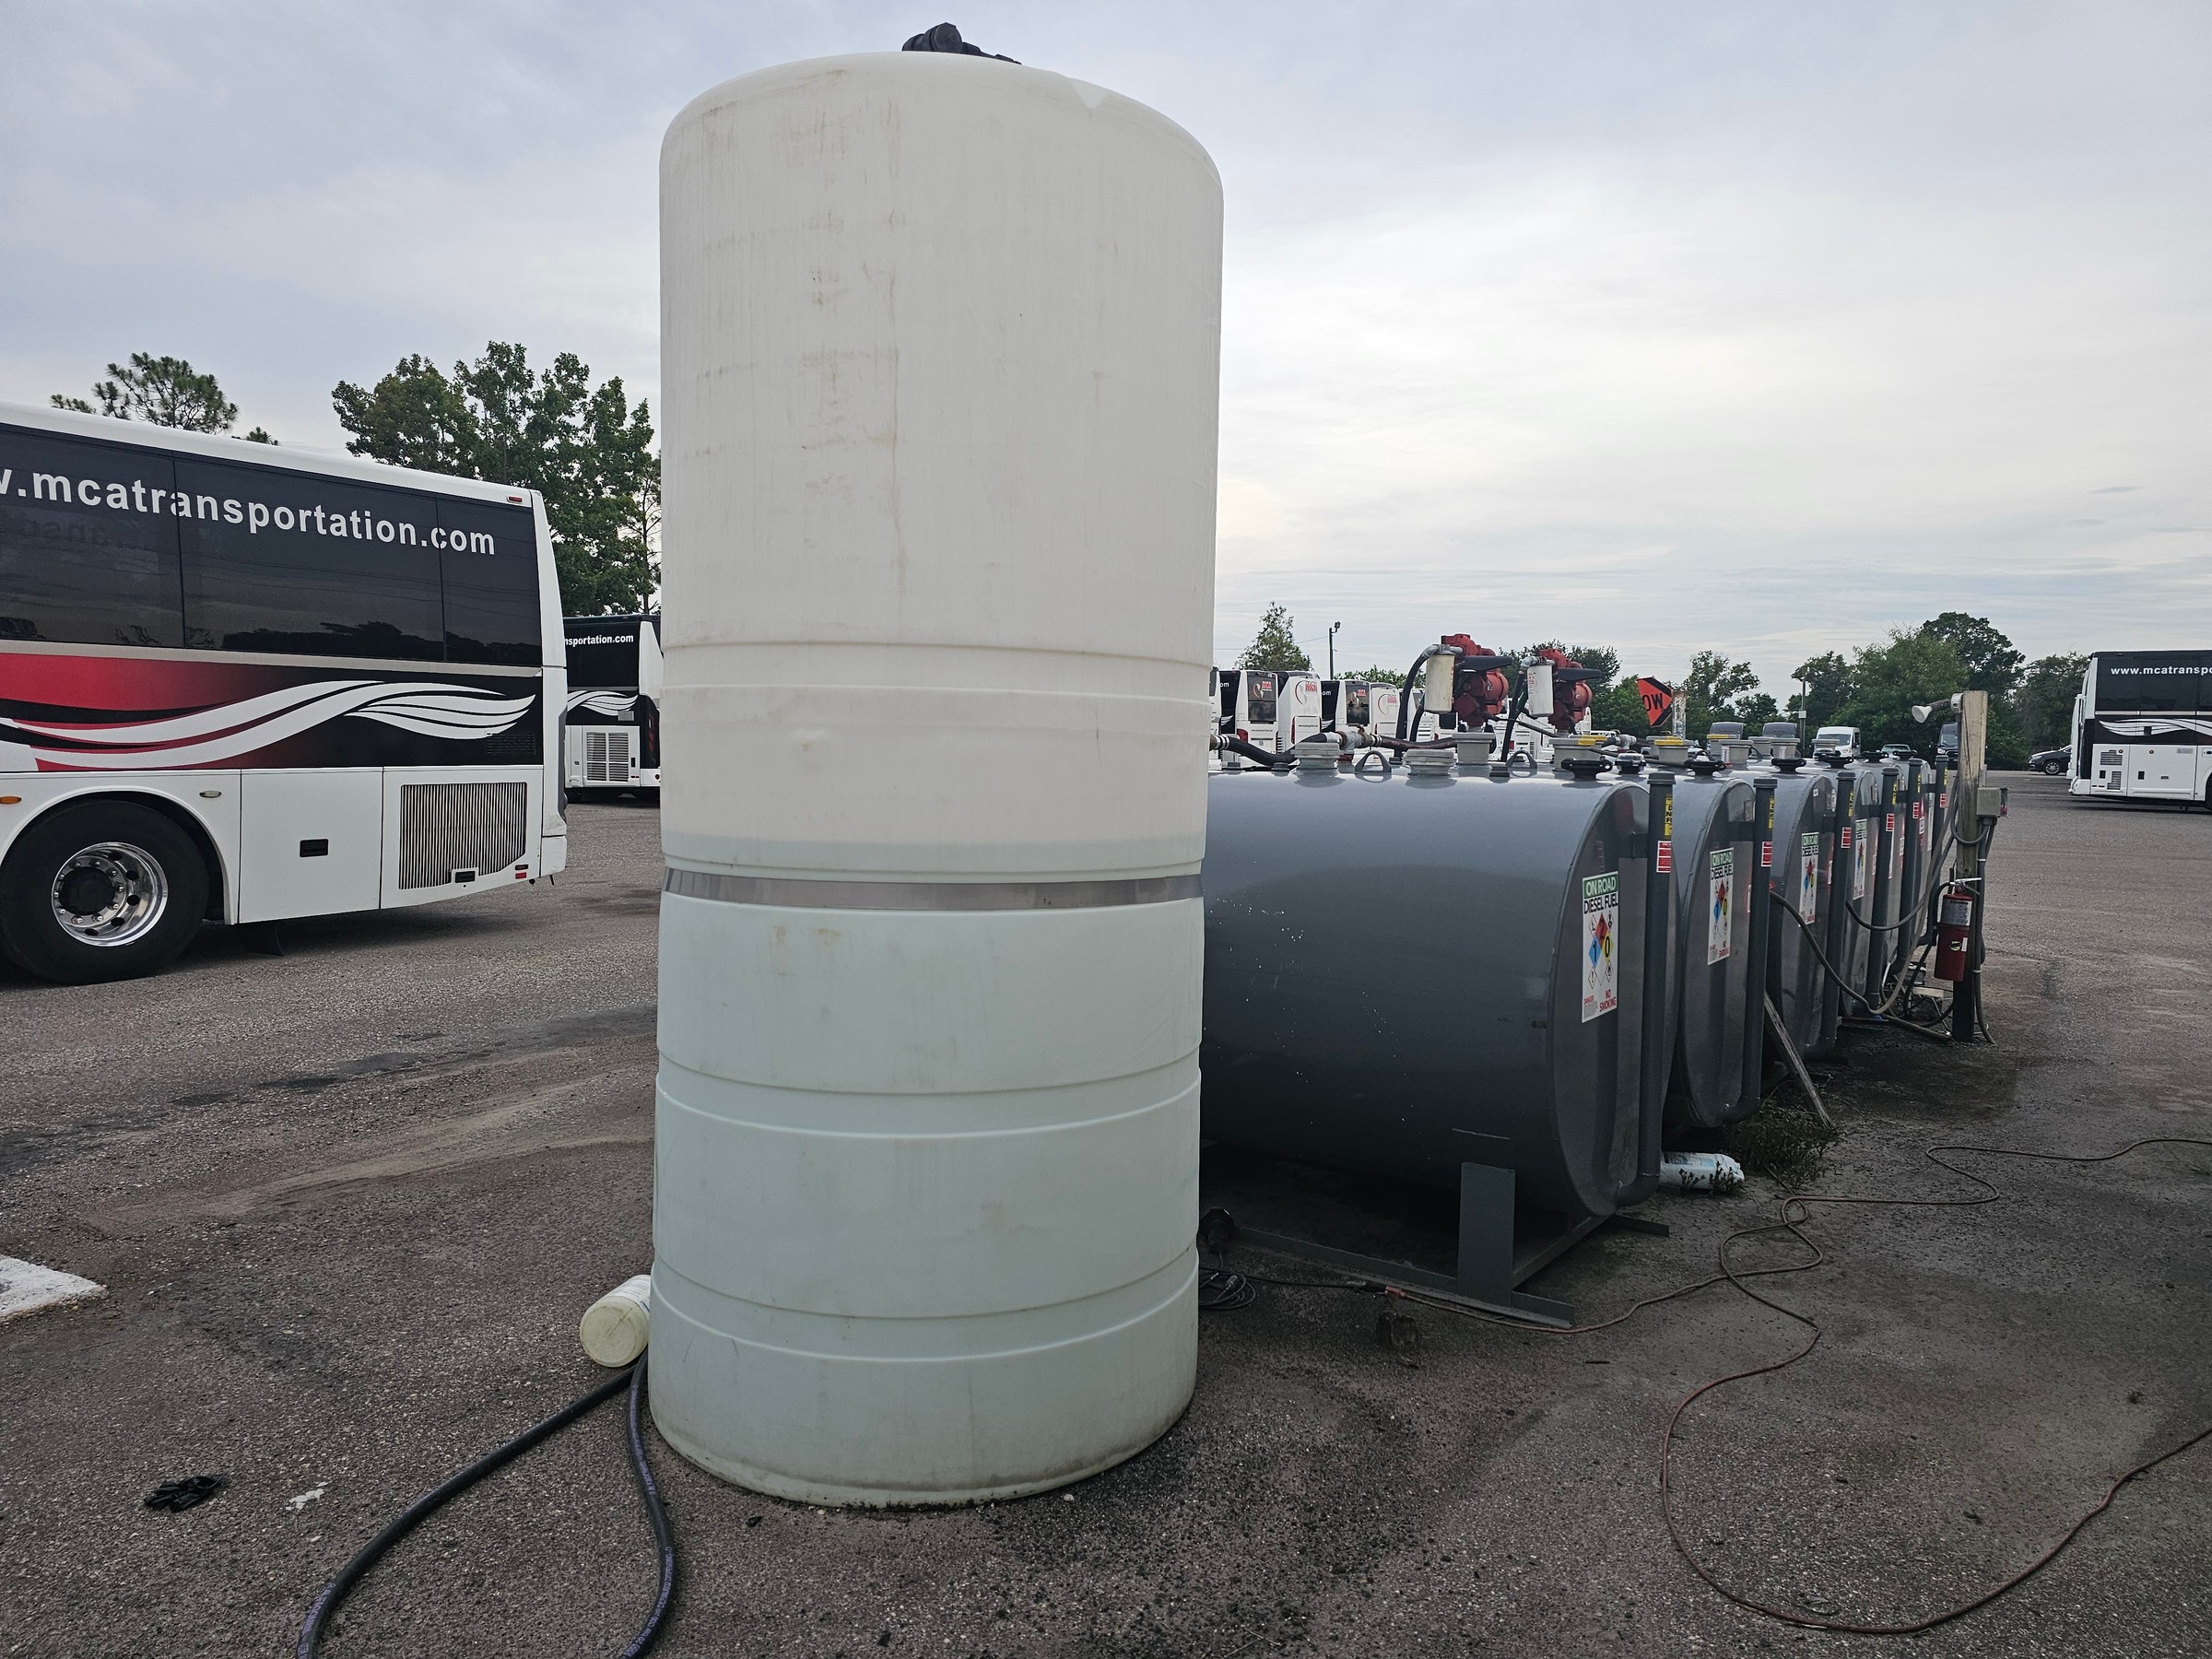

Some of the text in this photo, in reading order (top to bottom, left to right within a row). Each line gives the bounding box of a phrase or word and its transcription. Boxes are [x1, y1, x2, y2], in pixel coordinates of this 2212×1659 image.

[1586, 877, 1617, 896] ON ROAD
[1584, 894, 1618, 914] DIESEL FUEL
[1593, 940, 1597, 962] 1
[1605, 935, 1610, 958] 0
[1605, 989, 1611, 999] NO
[1599, 996, 1616, 1012] SMOKING
